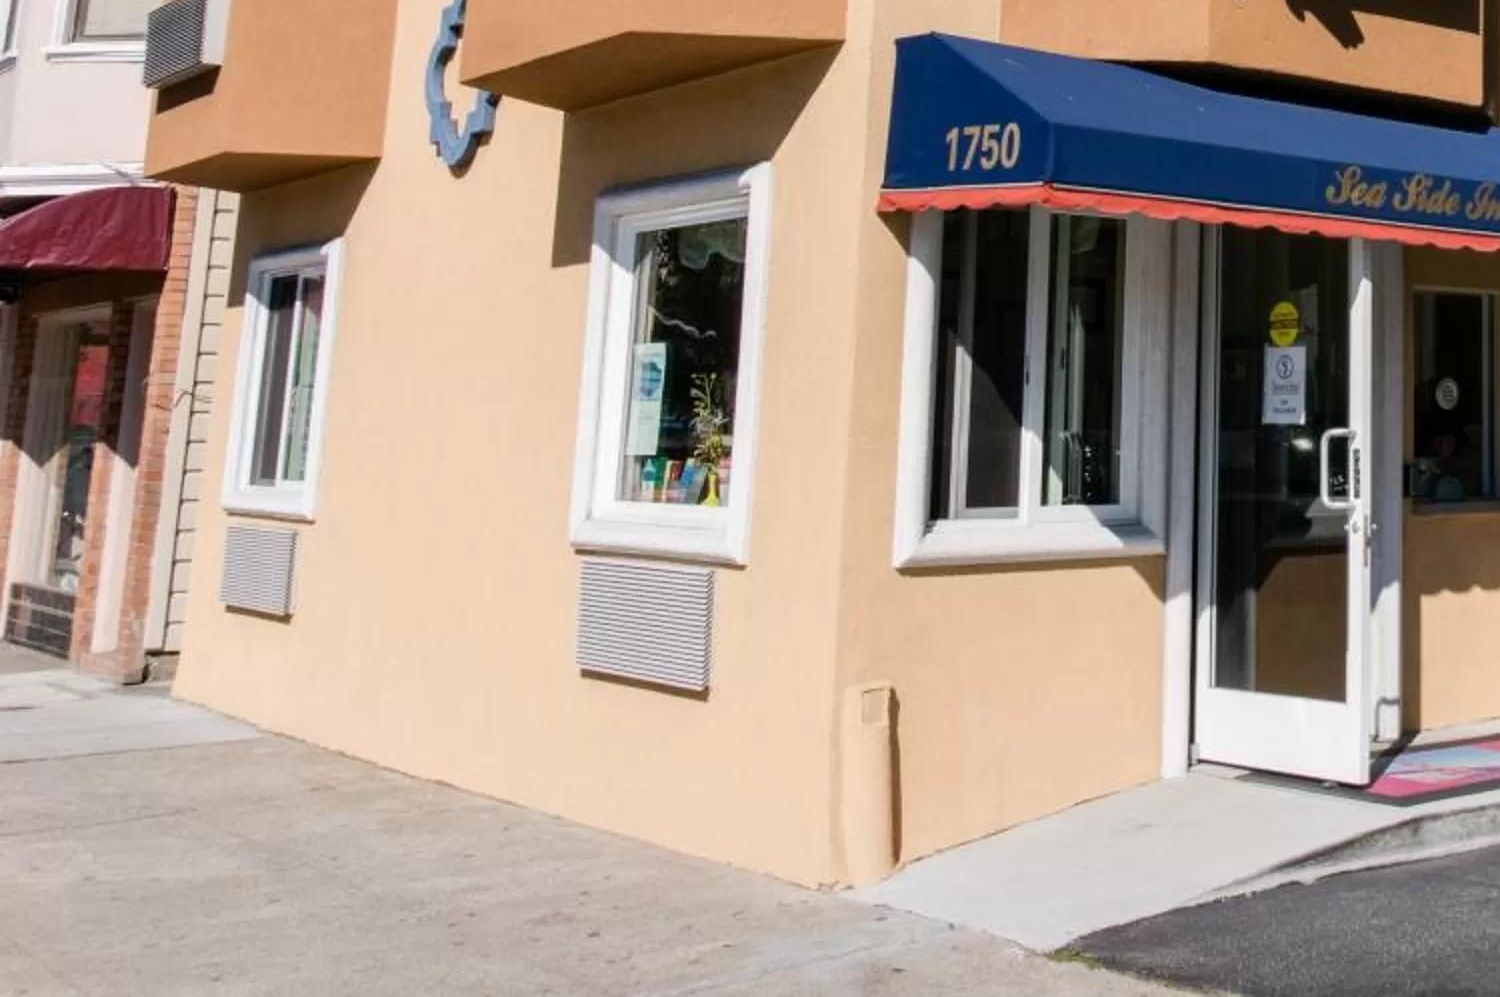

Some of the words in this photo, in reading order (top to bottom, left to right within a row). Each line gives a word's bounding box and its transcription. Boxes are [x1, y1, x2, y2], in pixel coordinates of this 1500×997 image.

[945, 122, 1021, 172] 1750
[1325, 165, 1387, 209] Sea
[1392, 172, 1461, 217] Side
